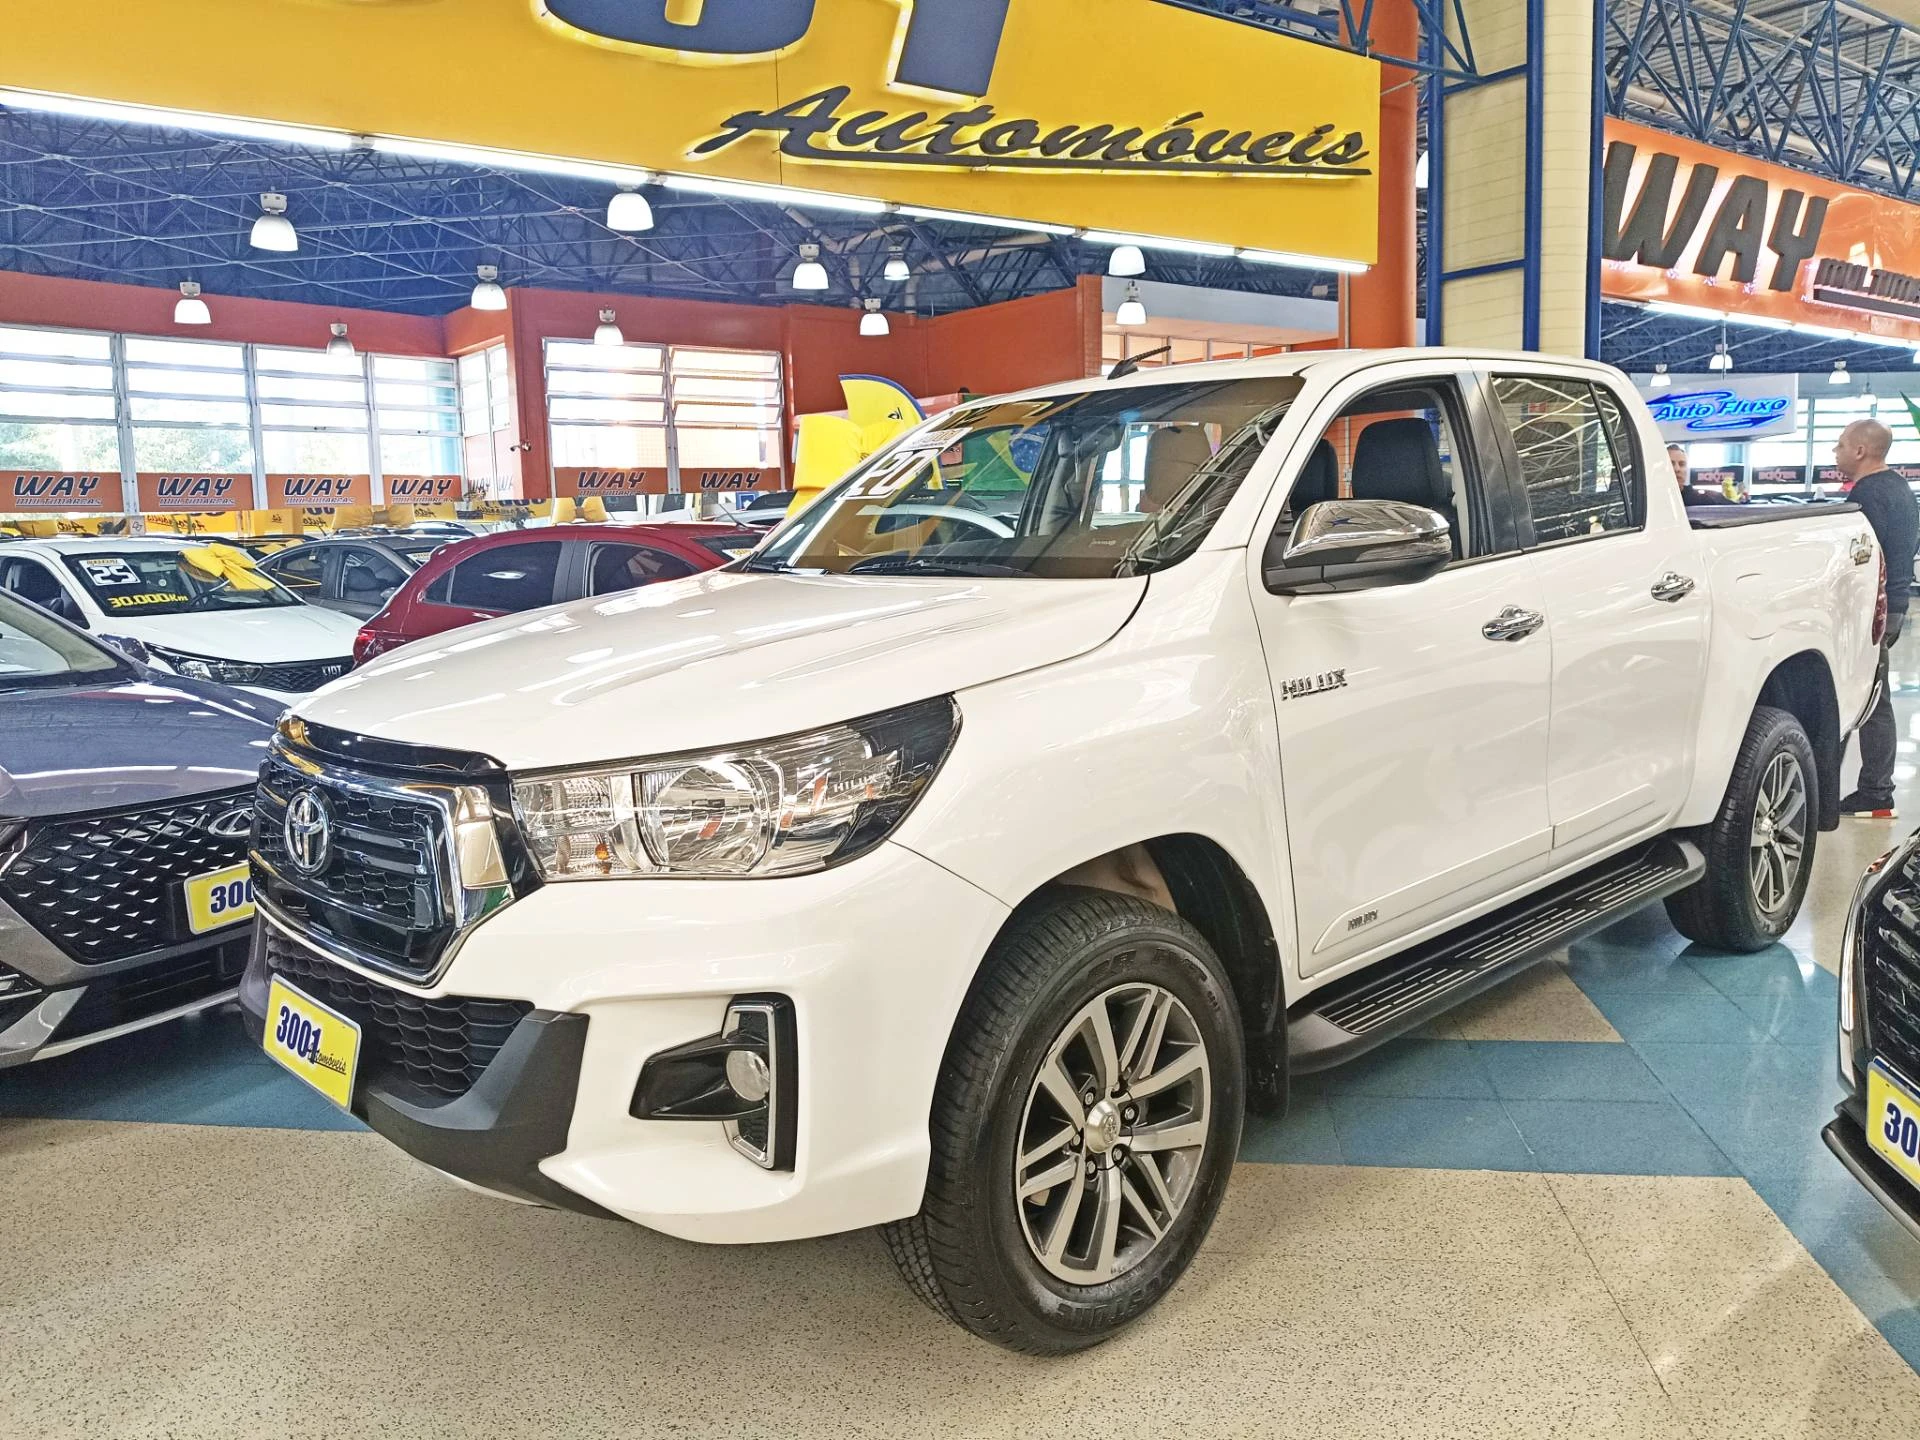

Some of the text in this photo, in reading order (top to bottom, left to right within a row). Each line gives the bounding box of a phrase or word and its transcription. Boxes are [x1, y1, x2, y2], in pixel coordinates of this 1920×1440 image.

[692, 84, 1371, 175] Automóveis
[1602, 141, 1829, 293] WAY
[1653, 397, 1789, 420] Auto Fluxo
[14, 475, 100, 496] WAY
[157, 477, 234, 497] WAY
[283, 478, 353, 497] WAY
[391, 478, 452, 496] WAY
[577, 471, 647, 490] WAY
[700, 472, 761, 490] WAY
[88, 565, 138, 585] 25
[1280, 667, 1348, 701] HILUX
[276, 1005, 322, 1065] 3001
[1884, 1102, 1920, 1166] 30
